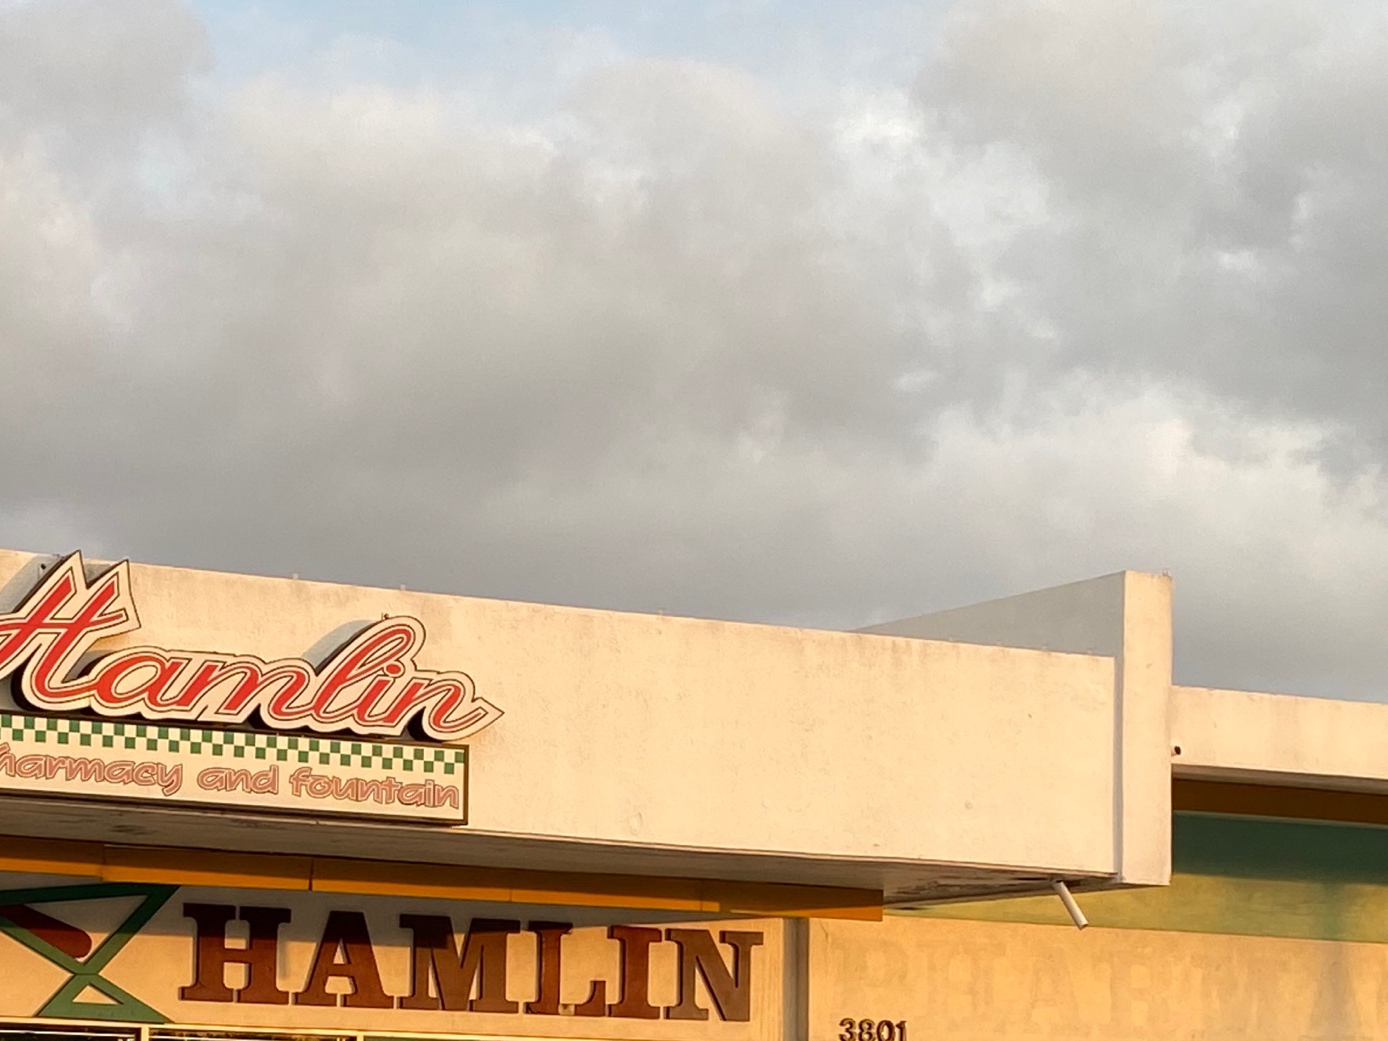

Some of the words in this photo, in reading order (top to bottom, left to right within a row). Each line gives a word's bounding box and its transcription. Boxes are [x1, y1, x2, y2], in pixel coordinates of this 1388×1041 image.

[196, 764, 280, 795] and
[288, 767, 460, 809] fountain
[178, 902, 764, 1023] HAMLIN
